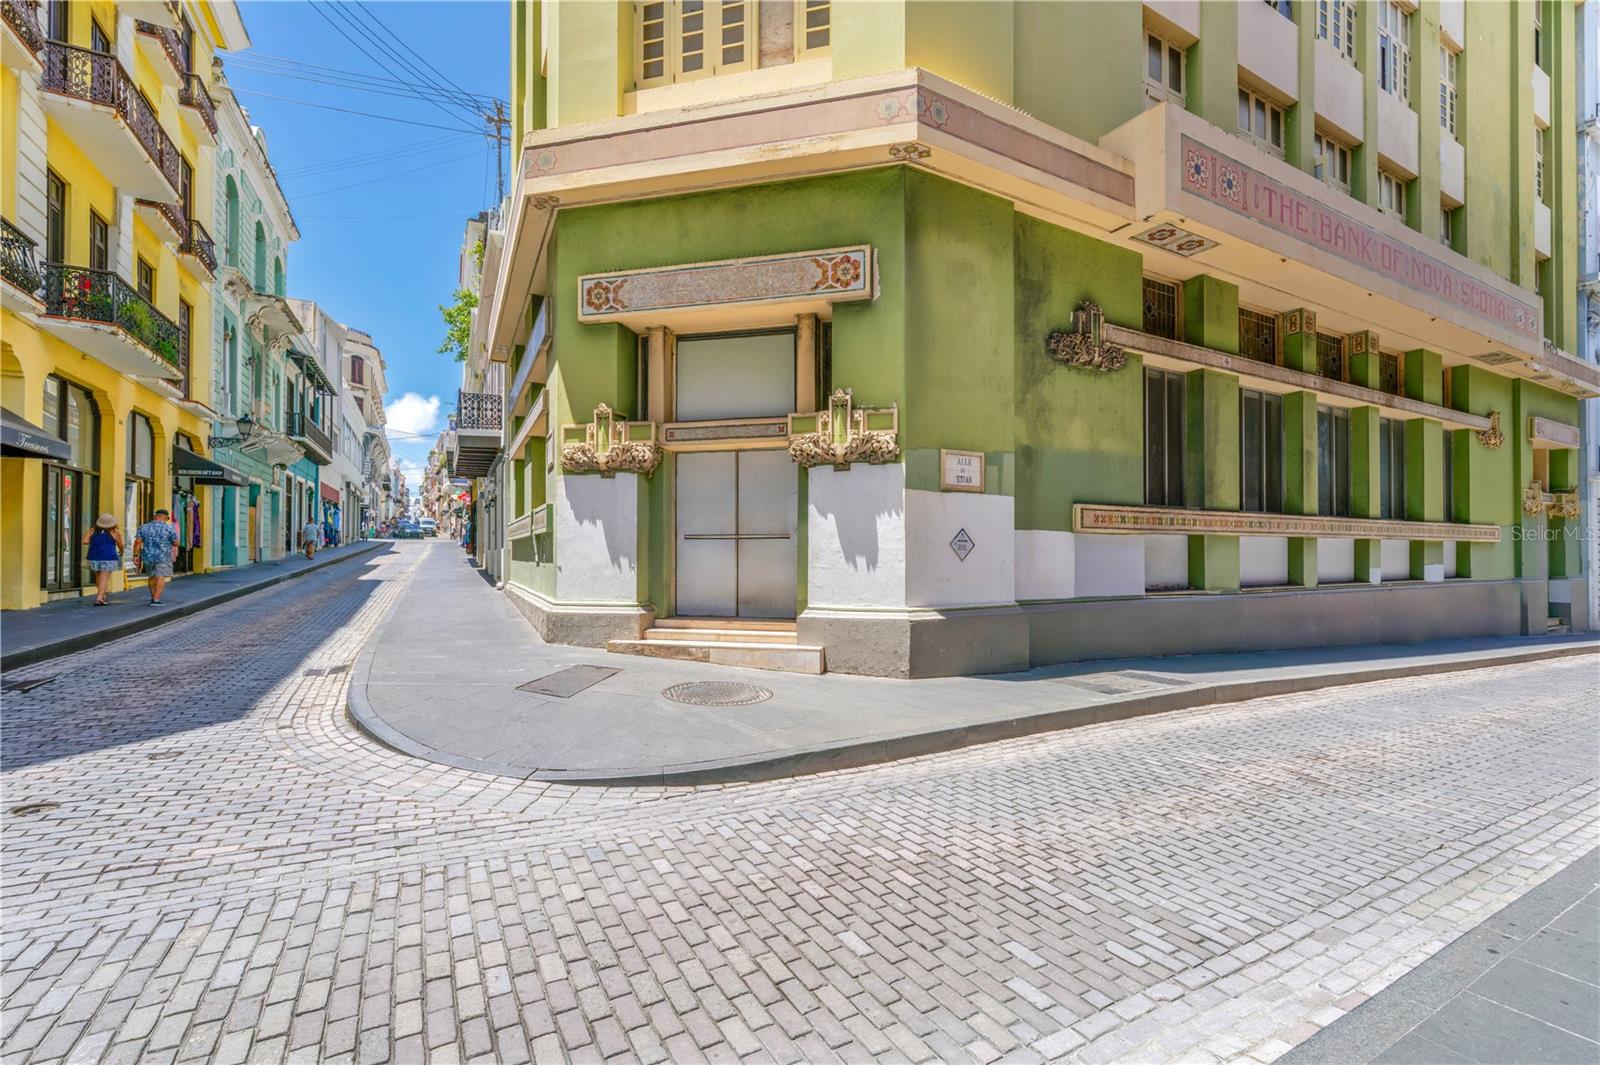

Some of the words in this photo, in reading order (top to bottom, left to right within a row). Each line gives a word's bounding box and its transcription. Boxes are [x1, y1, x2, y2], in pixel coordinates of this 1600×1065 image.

[1263, 185, 1308, 234] THE
[1320, 212, 1372, 262] BANK
[1381, 243, 1403, 273] OF
[1411, 257, 1452, 297] NOVA
[1460, 281, 1506, 320] SCOTIA
